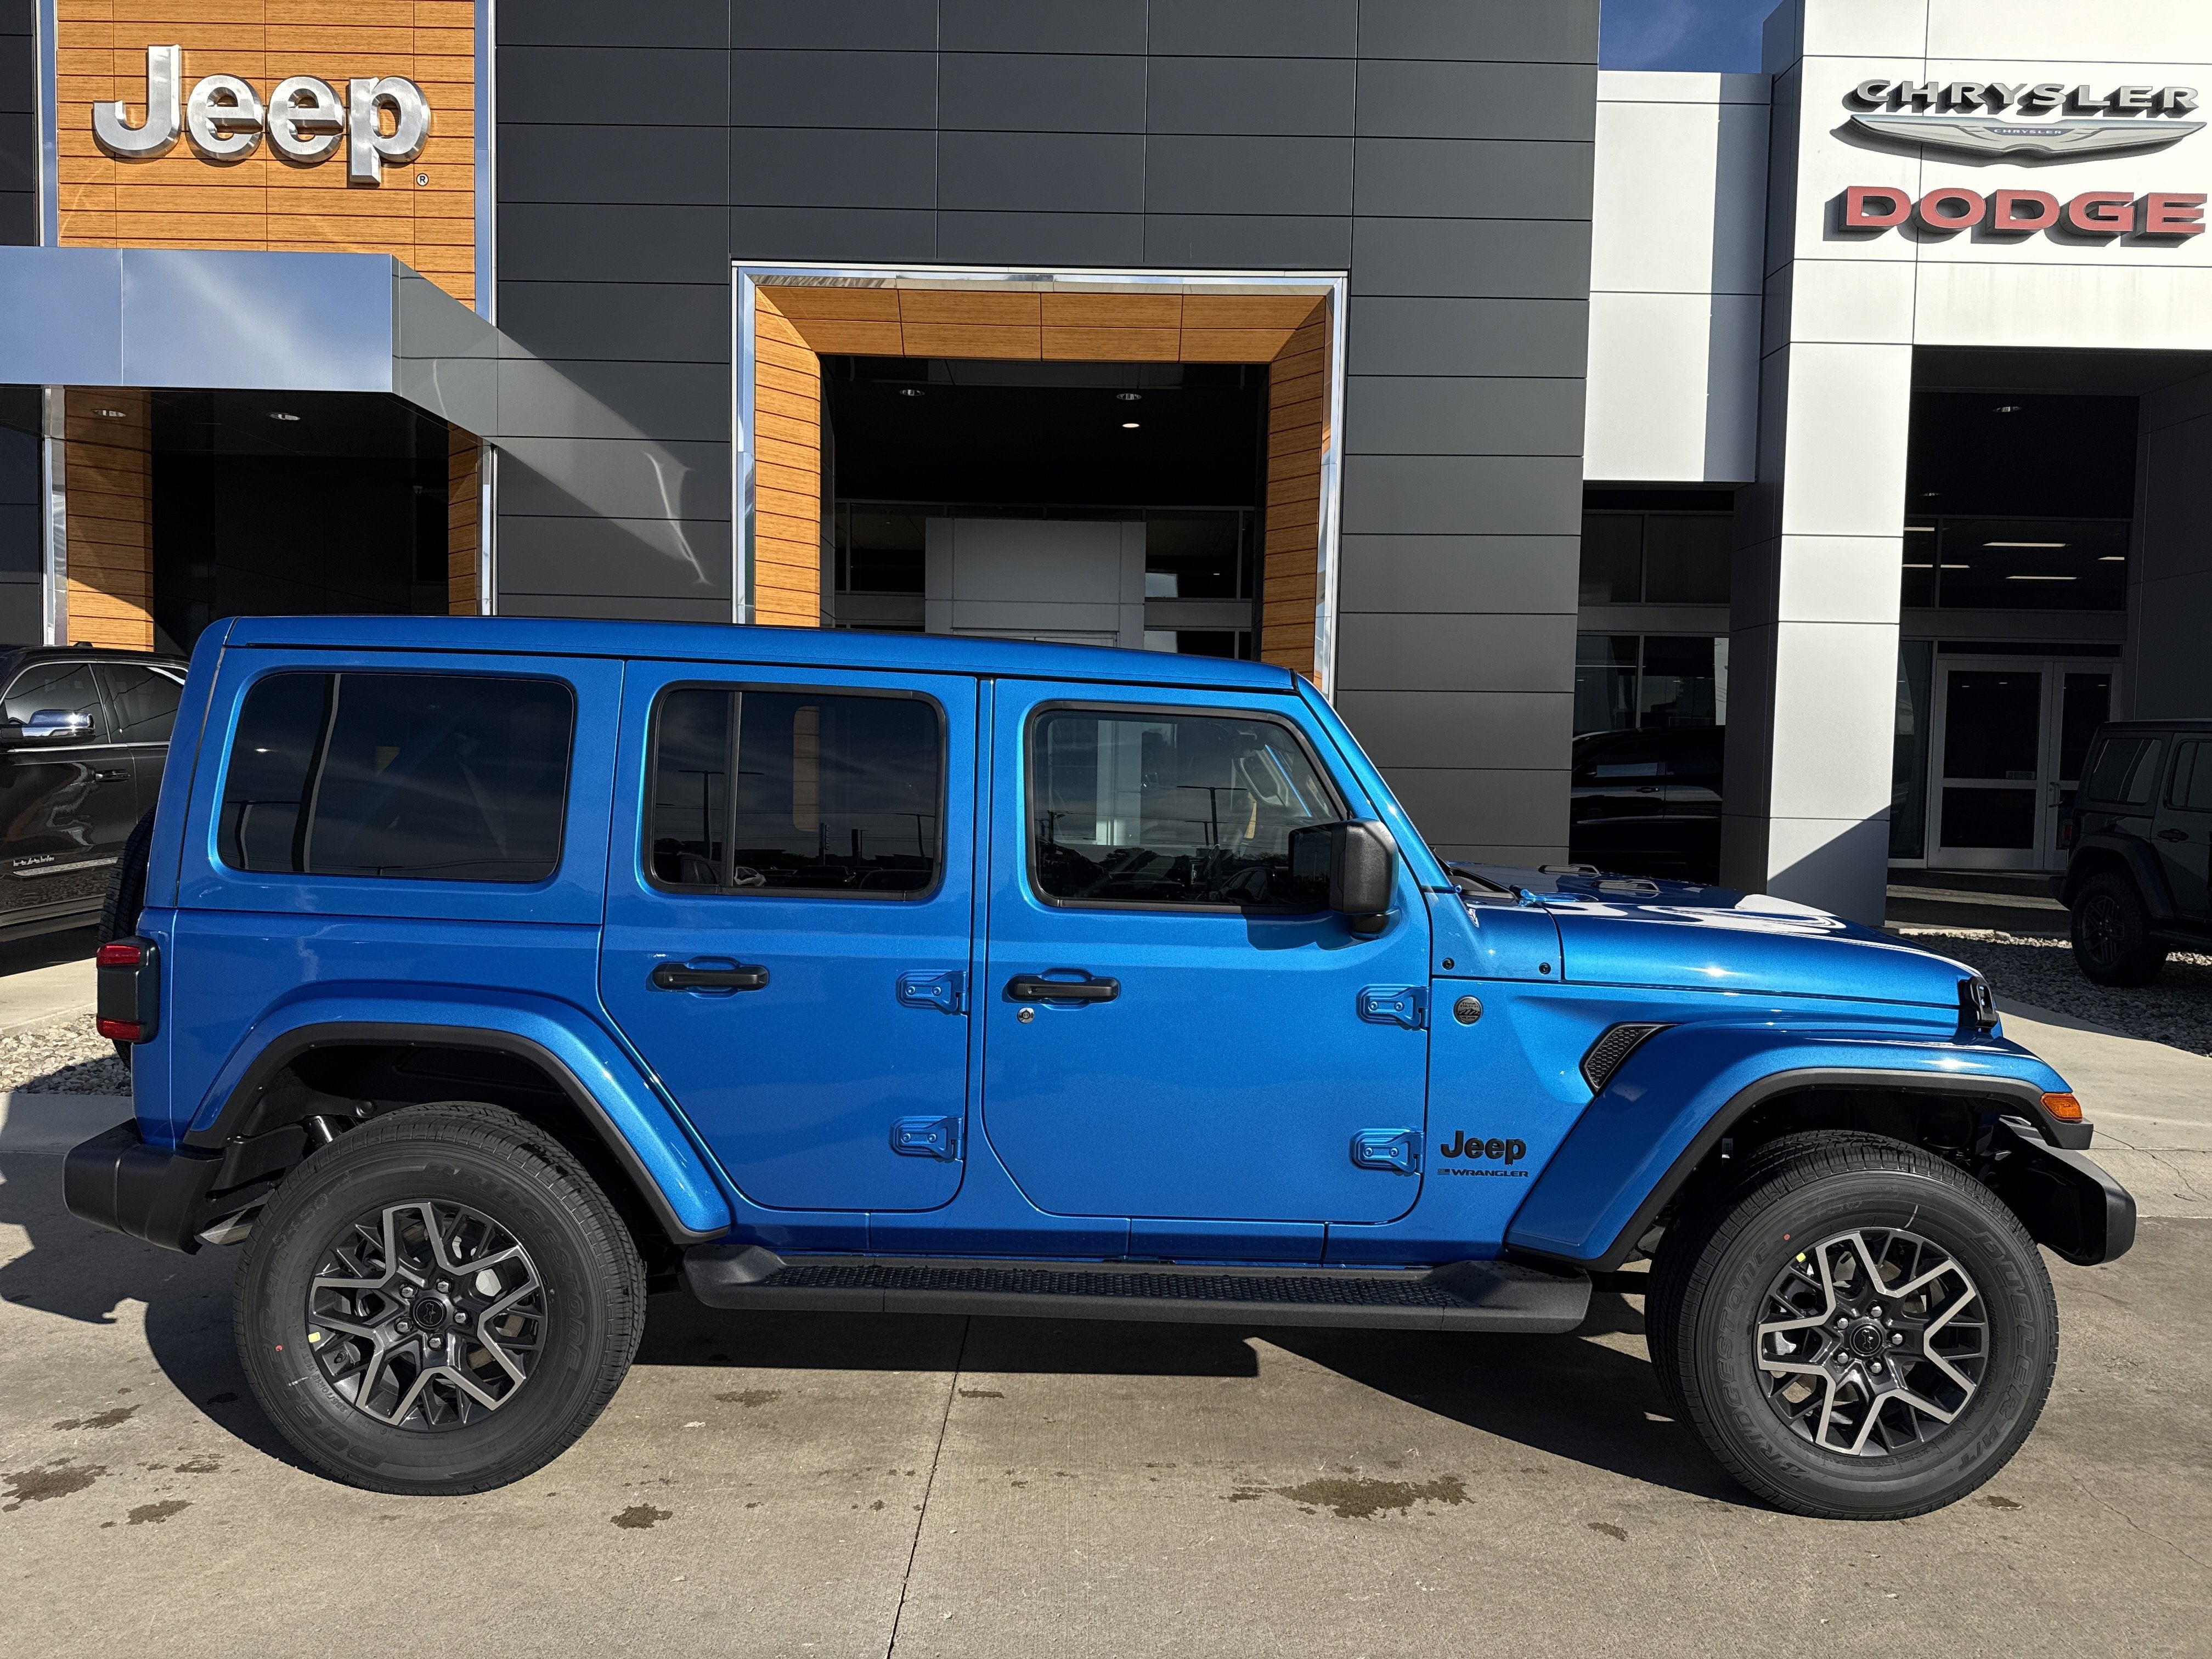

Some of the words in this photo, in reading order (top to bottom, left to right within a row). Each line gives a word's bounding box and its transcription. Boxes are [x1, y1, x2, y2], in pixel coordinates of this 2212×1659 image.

[92, 44, 431, 184] Jeep
[1854, 78, 2199, 109] CHRYSLER
[1846, 185, 2208, 234] DODGE
[1441, 1130, 1526, 1165] Jeep
[1451, 1169, 1529, 1177] WRANGLER
[424, 1165, 583, 1370] BRIDGESTONE
[1718, 1242, 1810, 1480] BRIDGESTONE
[1970, 1232, 2034, 1422] DUELER
